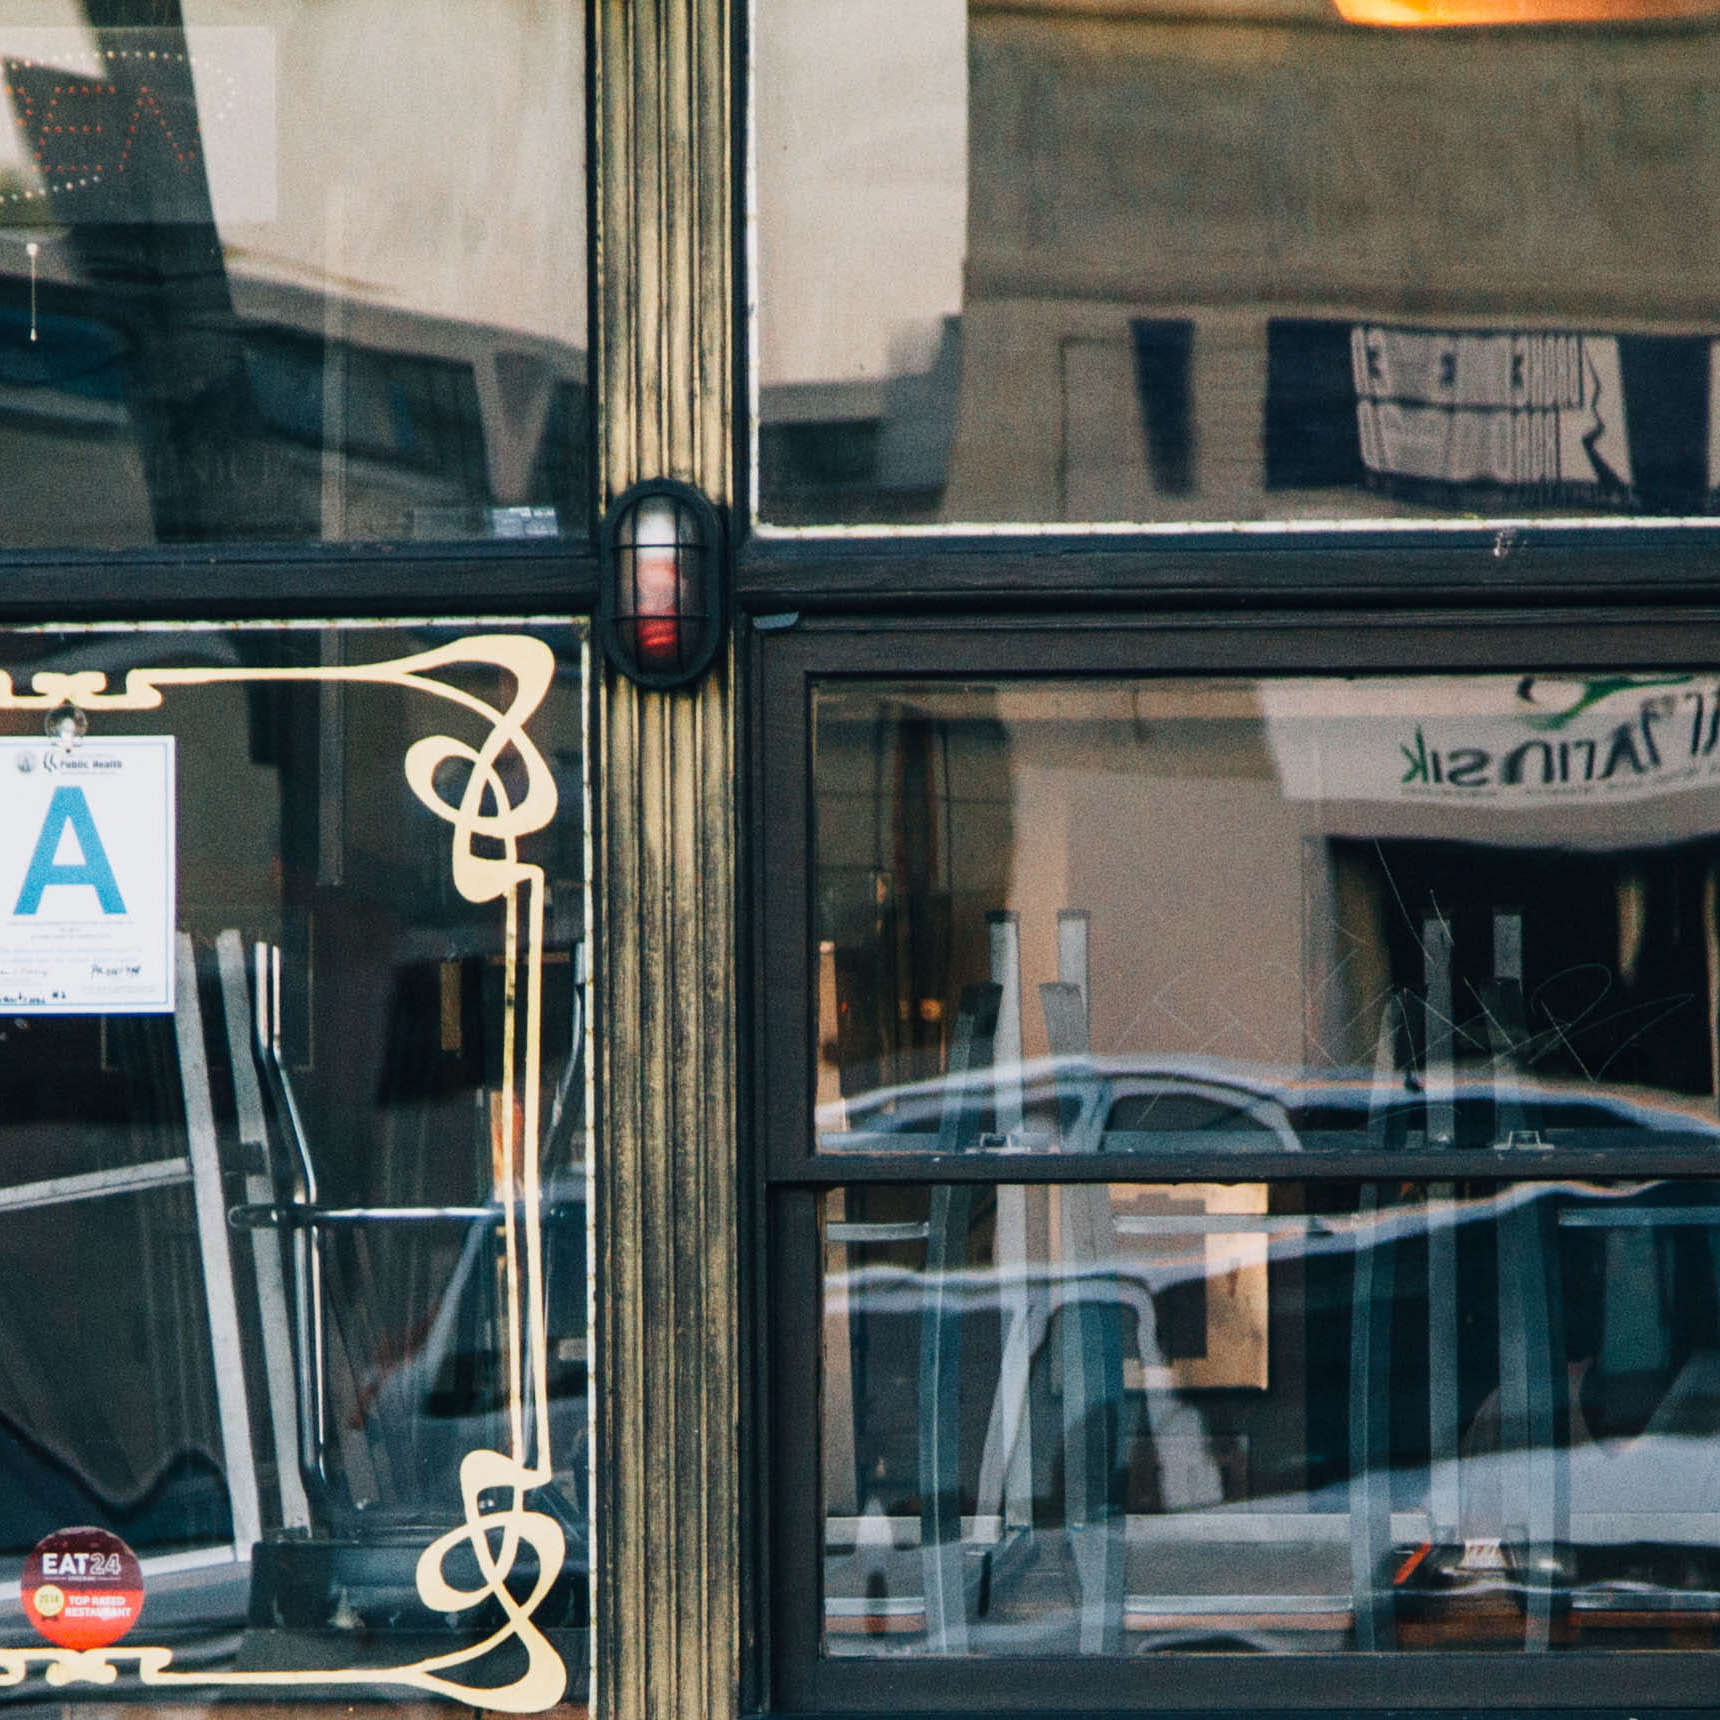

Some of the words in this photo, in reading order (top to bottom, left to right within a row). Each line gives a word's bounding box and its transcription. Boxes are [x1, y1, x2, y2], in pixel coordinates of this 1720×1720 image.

[13, 786, 127, 915] A
[42, 1553, 121, 1575] EAT24
[68, 1596, 90, 1606] TOP
[65, 1607, 130, 1617] RESTAURANT
